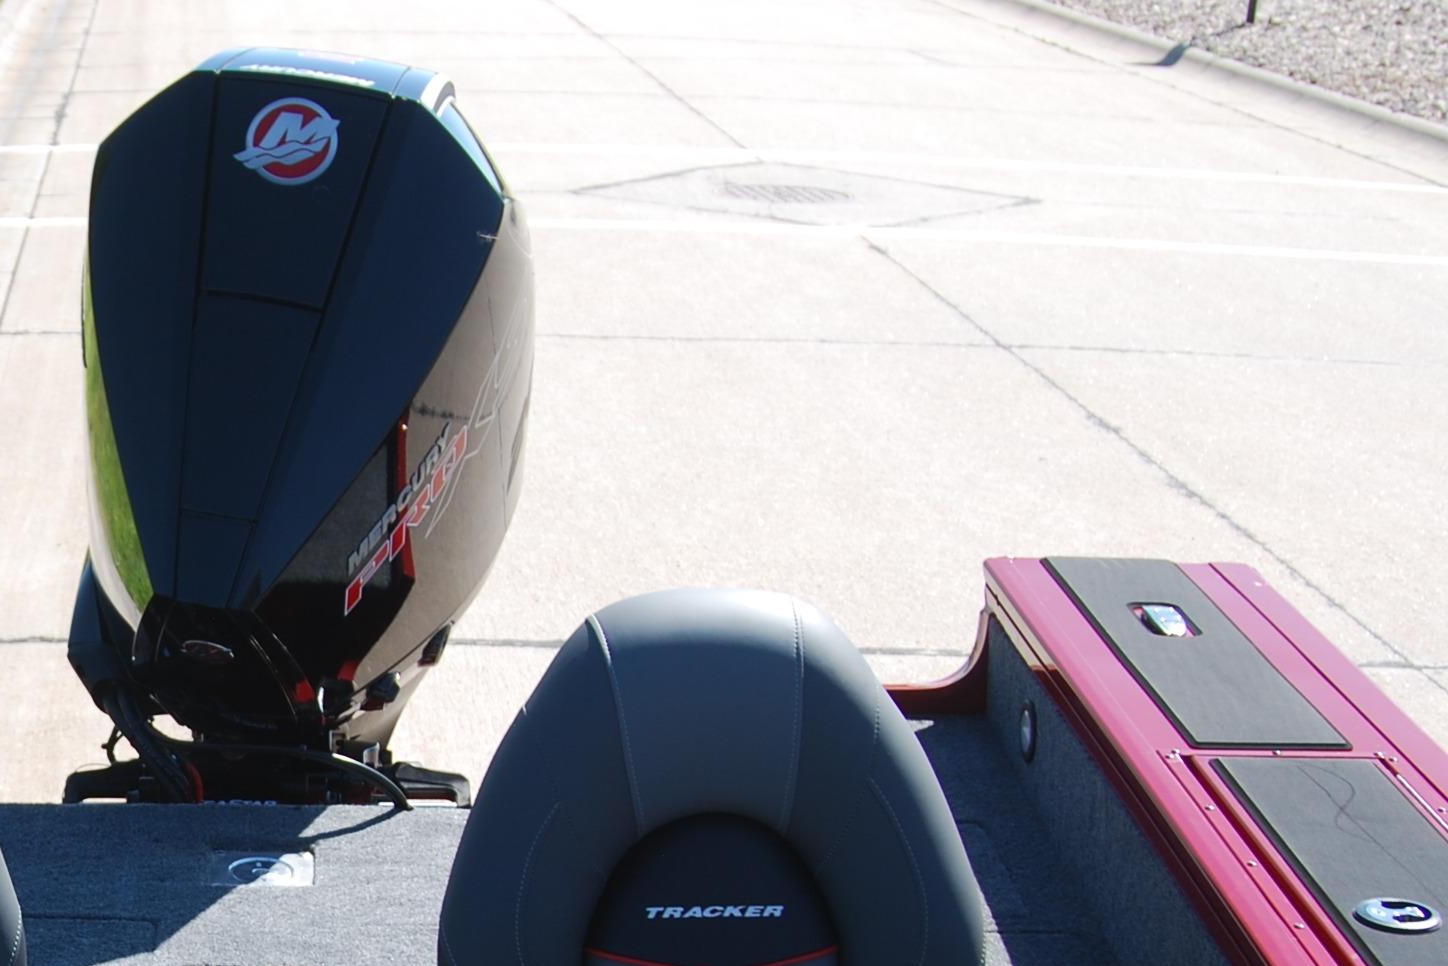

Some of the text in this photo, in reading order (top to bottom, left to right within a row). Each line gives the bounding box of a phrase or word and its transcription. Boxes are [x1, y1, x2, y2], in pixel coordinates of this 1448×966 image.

[344, 424, 468, 617] PRO
[347, 420, 452, 576] MERCURY
[645, 905, 785, 919] TRACKER
